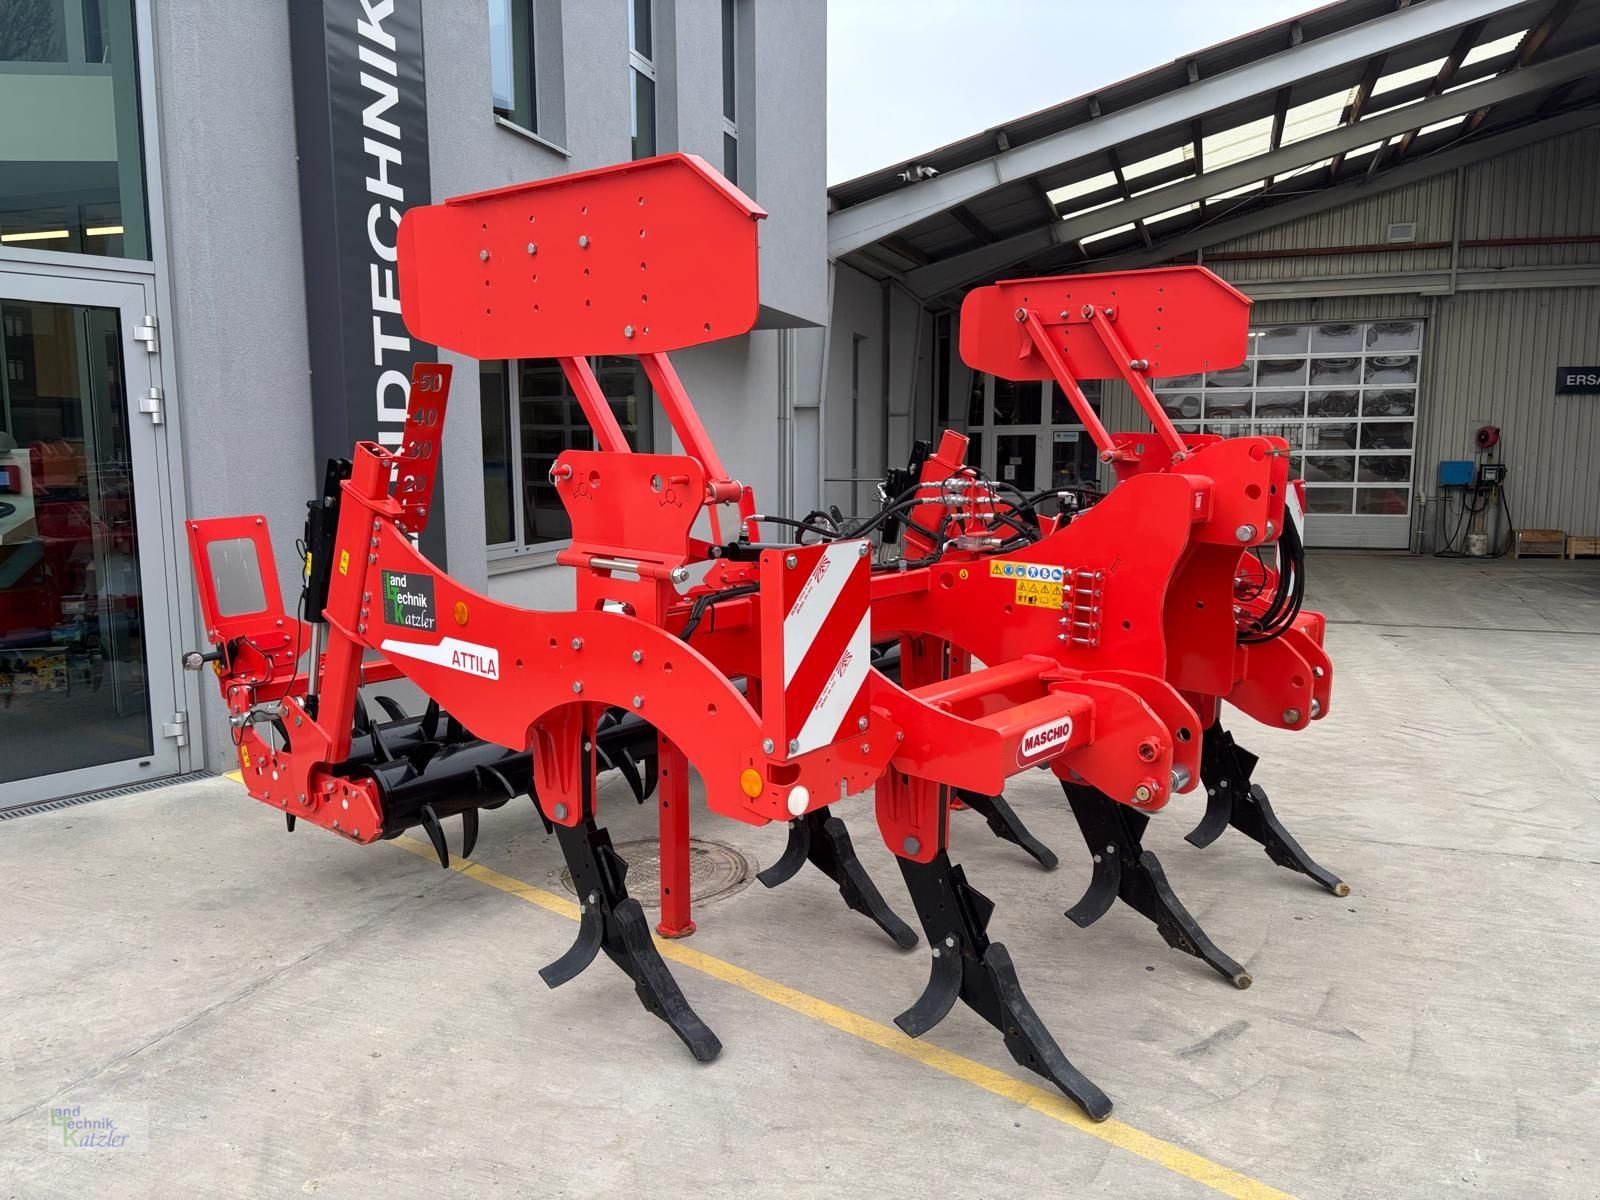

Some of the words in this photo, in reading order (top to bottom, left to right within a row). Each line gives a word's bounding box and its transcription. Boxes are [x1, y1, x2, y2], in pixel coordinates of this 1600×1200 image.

[419, 373, 443, 392] 50
[413, 408, 438, 427] 40
[408, 441, 432, 459] 30
[403, 475, 426, 493] 20
[394, 605, 435, 629] Katzler
[452, 650, 497, 677] ATTILA
[1024, 723, 1070, 752] MASCHIO
